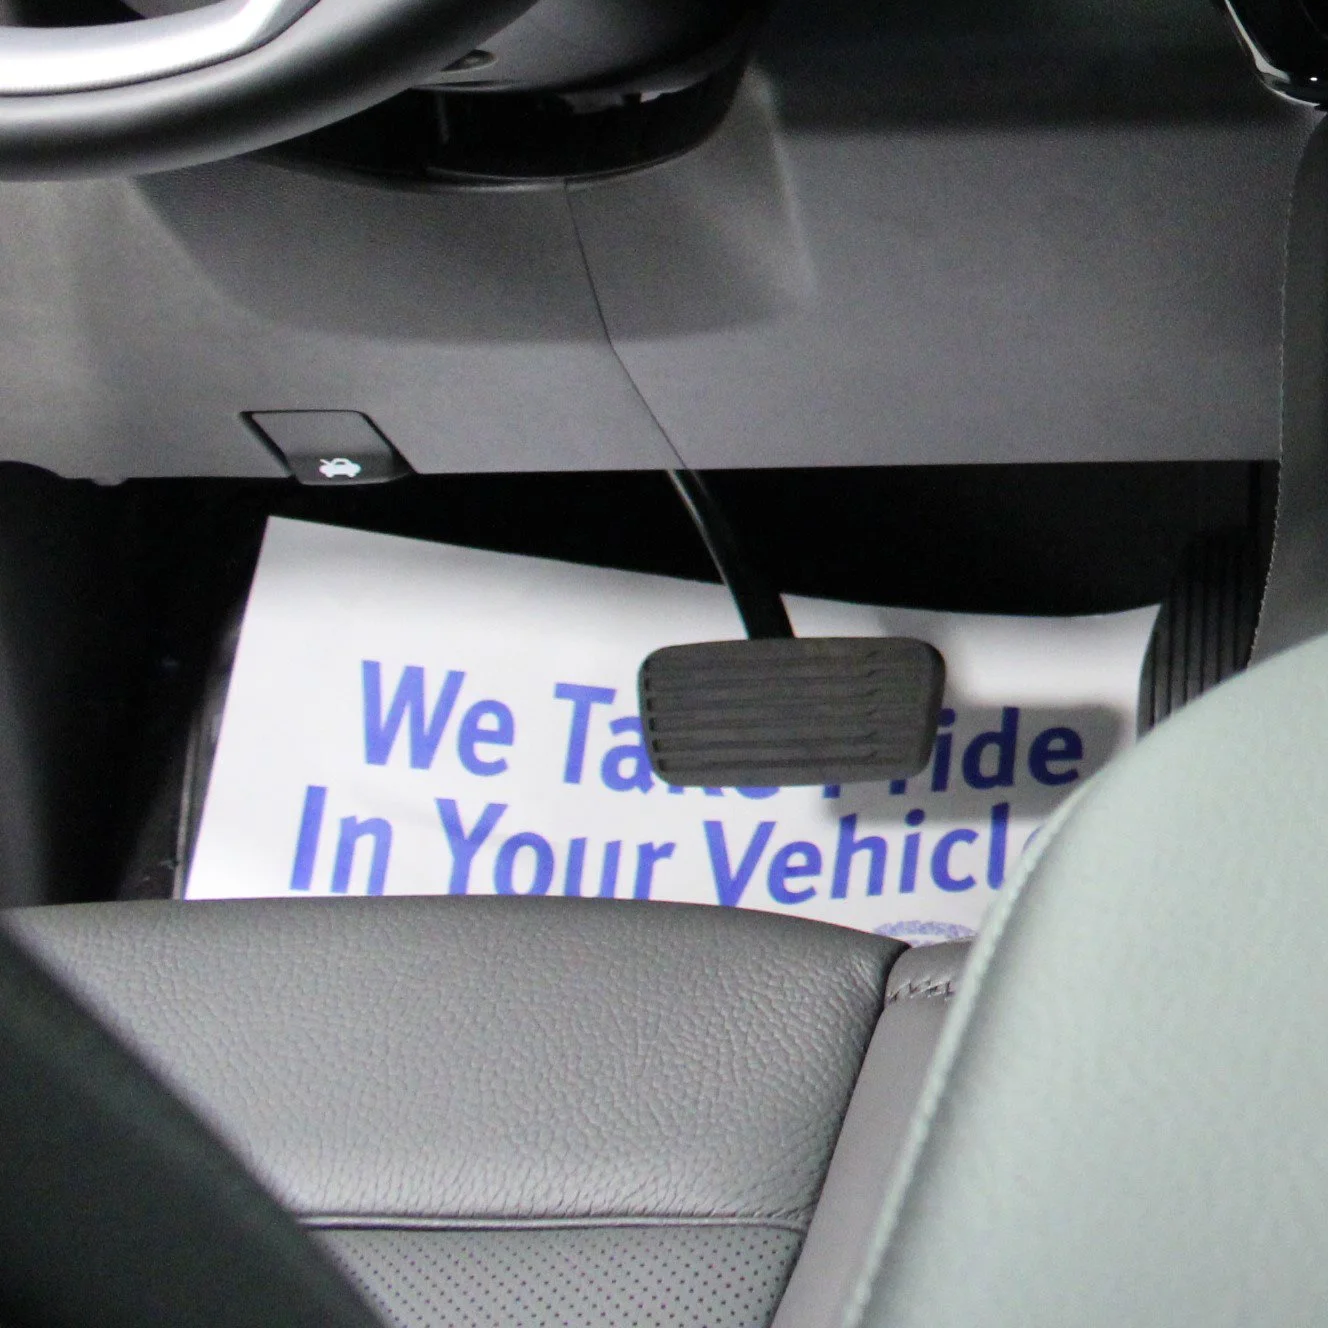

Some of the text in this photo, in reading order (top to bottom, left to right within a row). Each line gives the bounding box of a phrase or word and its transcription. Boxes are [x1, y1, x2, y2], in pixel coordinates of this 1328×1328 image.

[361, 660, 1084, 799] We Ta ide
[289, 784, 1046, 908] In Your Vehicl
